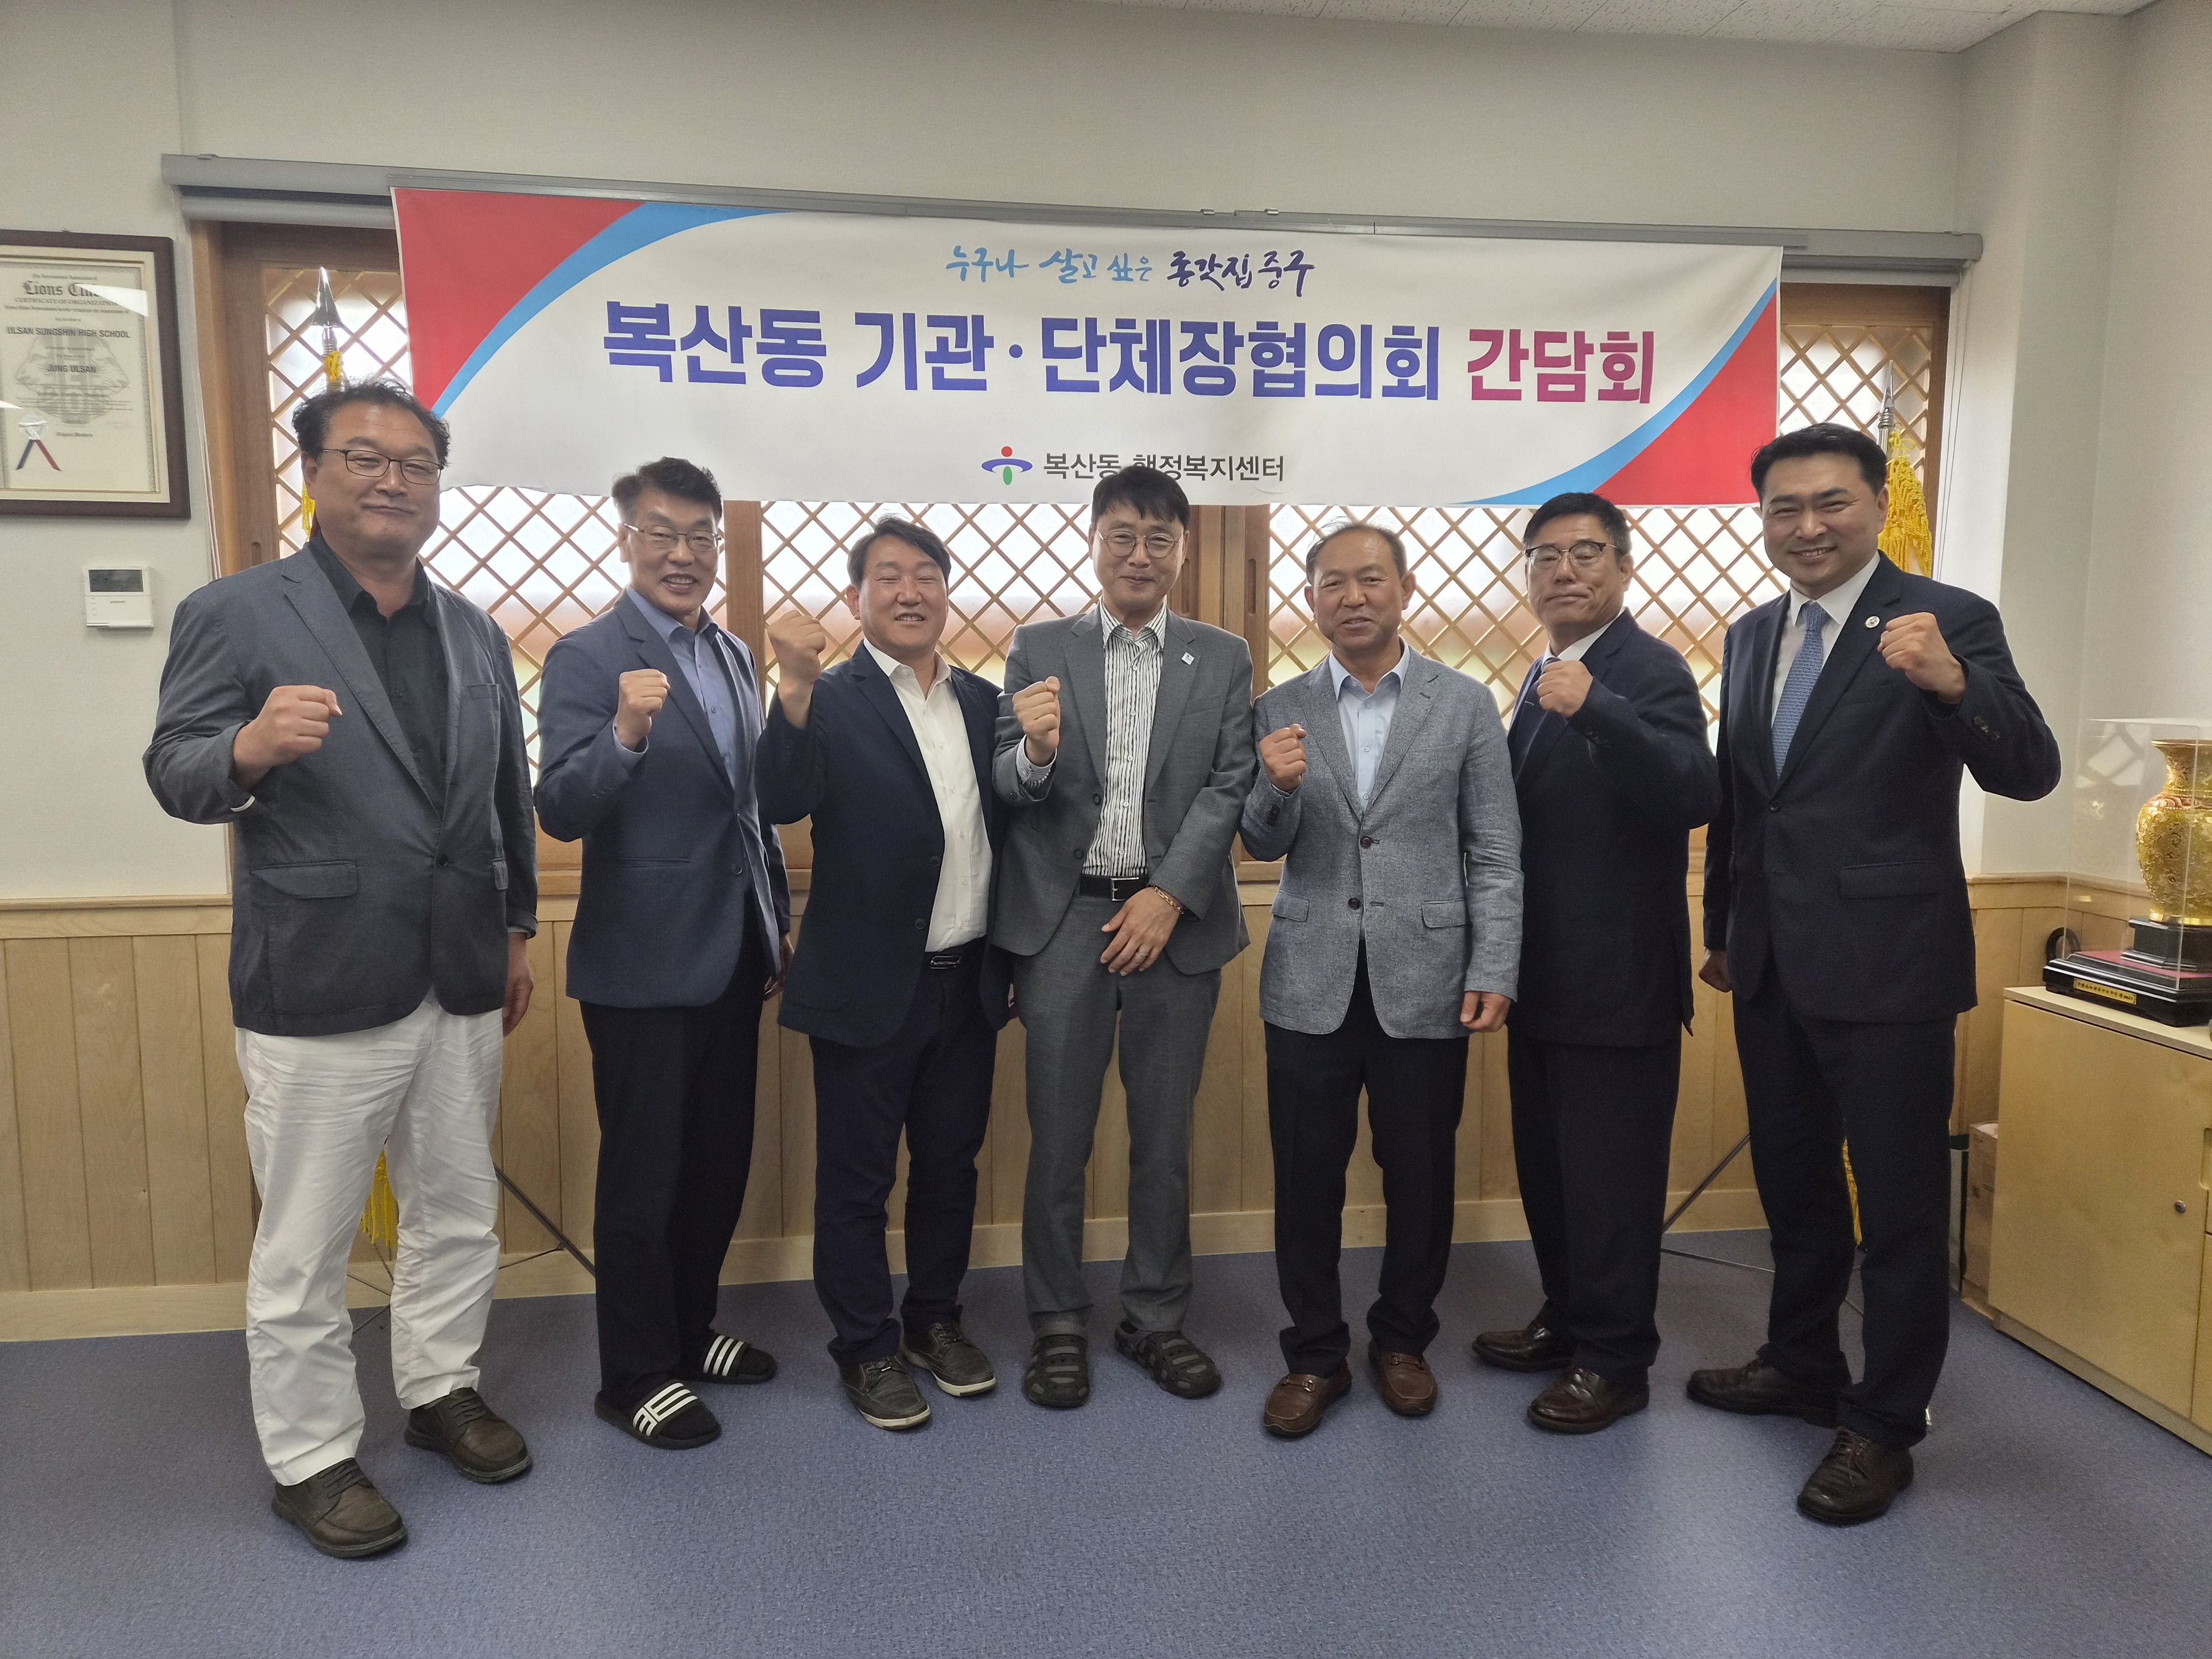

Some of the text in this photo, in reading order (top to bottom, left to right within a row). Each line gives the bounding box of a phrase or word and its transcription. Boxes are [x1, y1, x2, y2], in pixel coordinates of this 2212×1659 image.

[946, 245, 1316, 298] 누구나 살고 싶은 종갓집 중구
[22, 280, 102, 297] Lions Clu
[7, 326, 131, 338] ULSAN SUNGSHIN HIGH SCHOOL
[603, 300, 827, 388] 복산동
[1468, 328, 1655, 404] 간담회
[47, 364, 96, 373] JUNG ULSAN
[1044, 453, 1121, 479] 복산동
